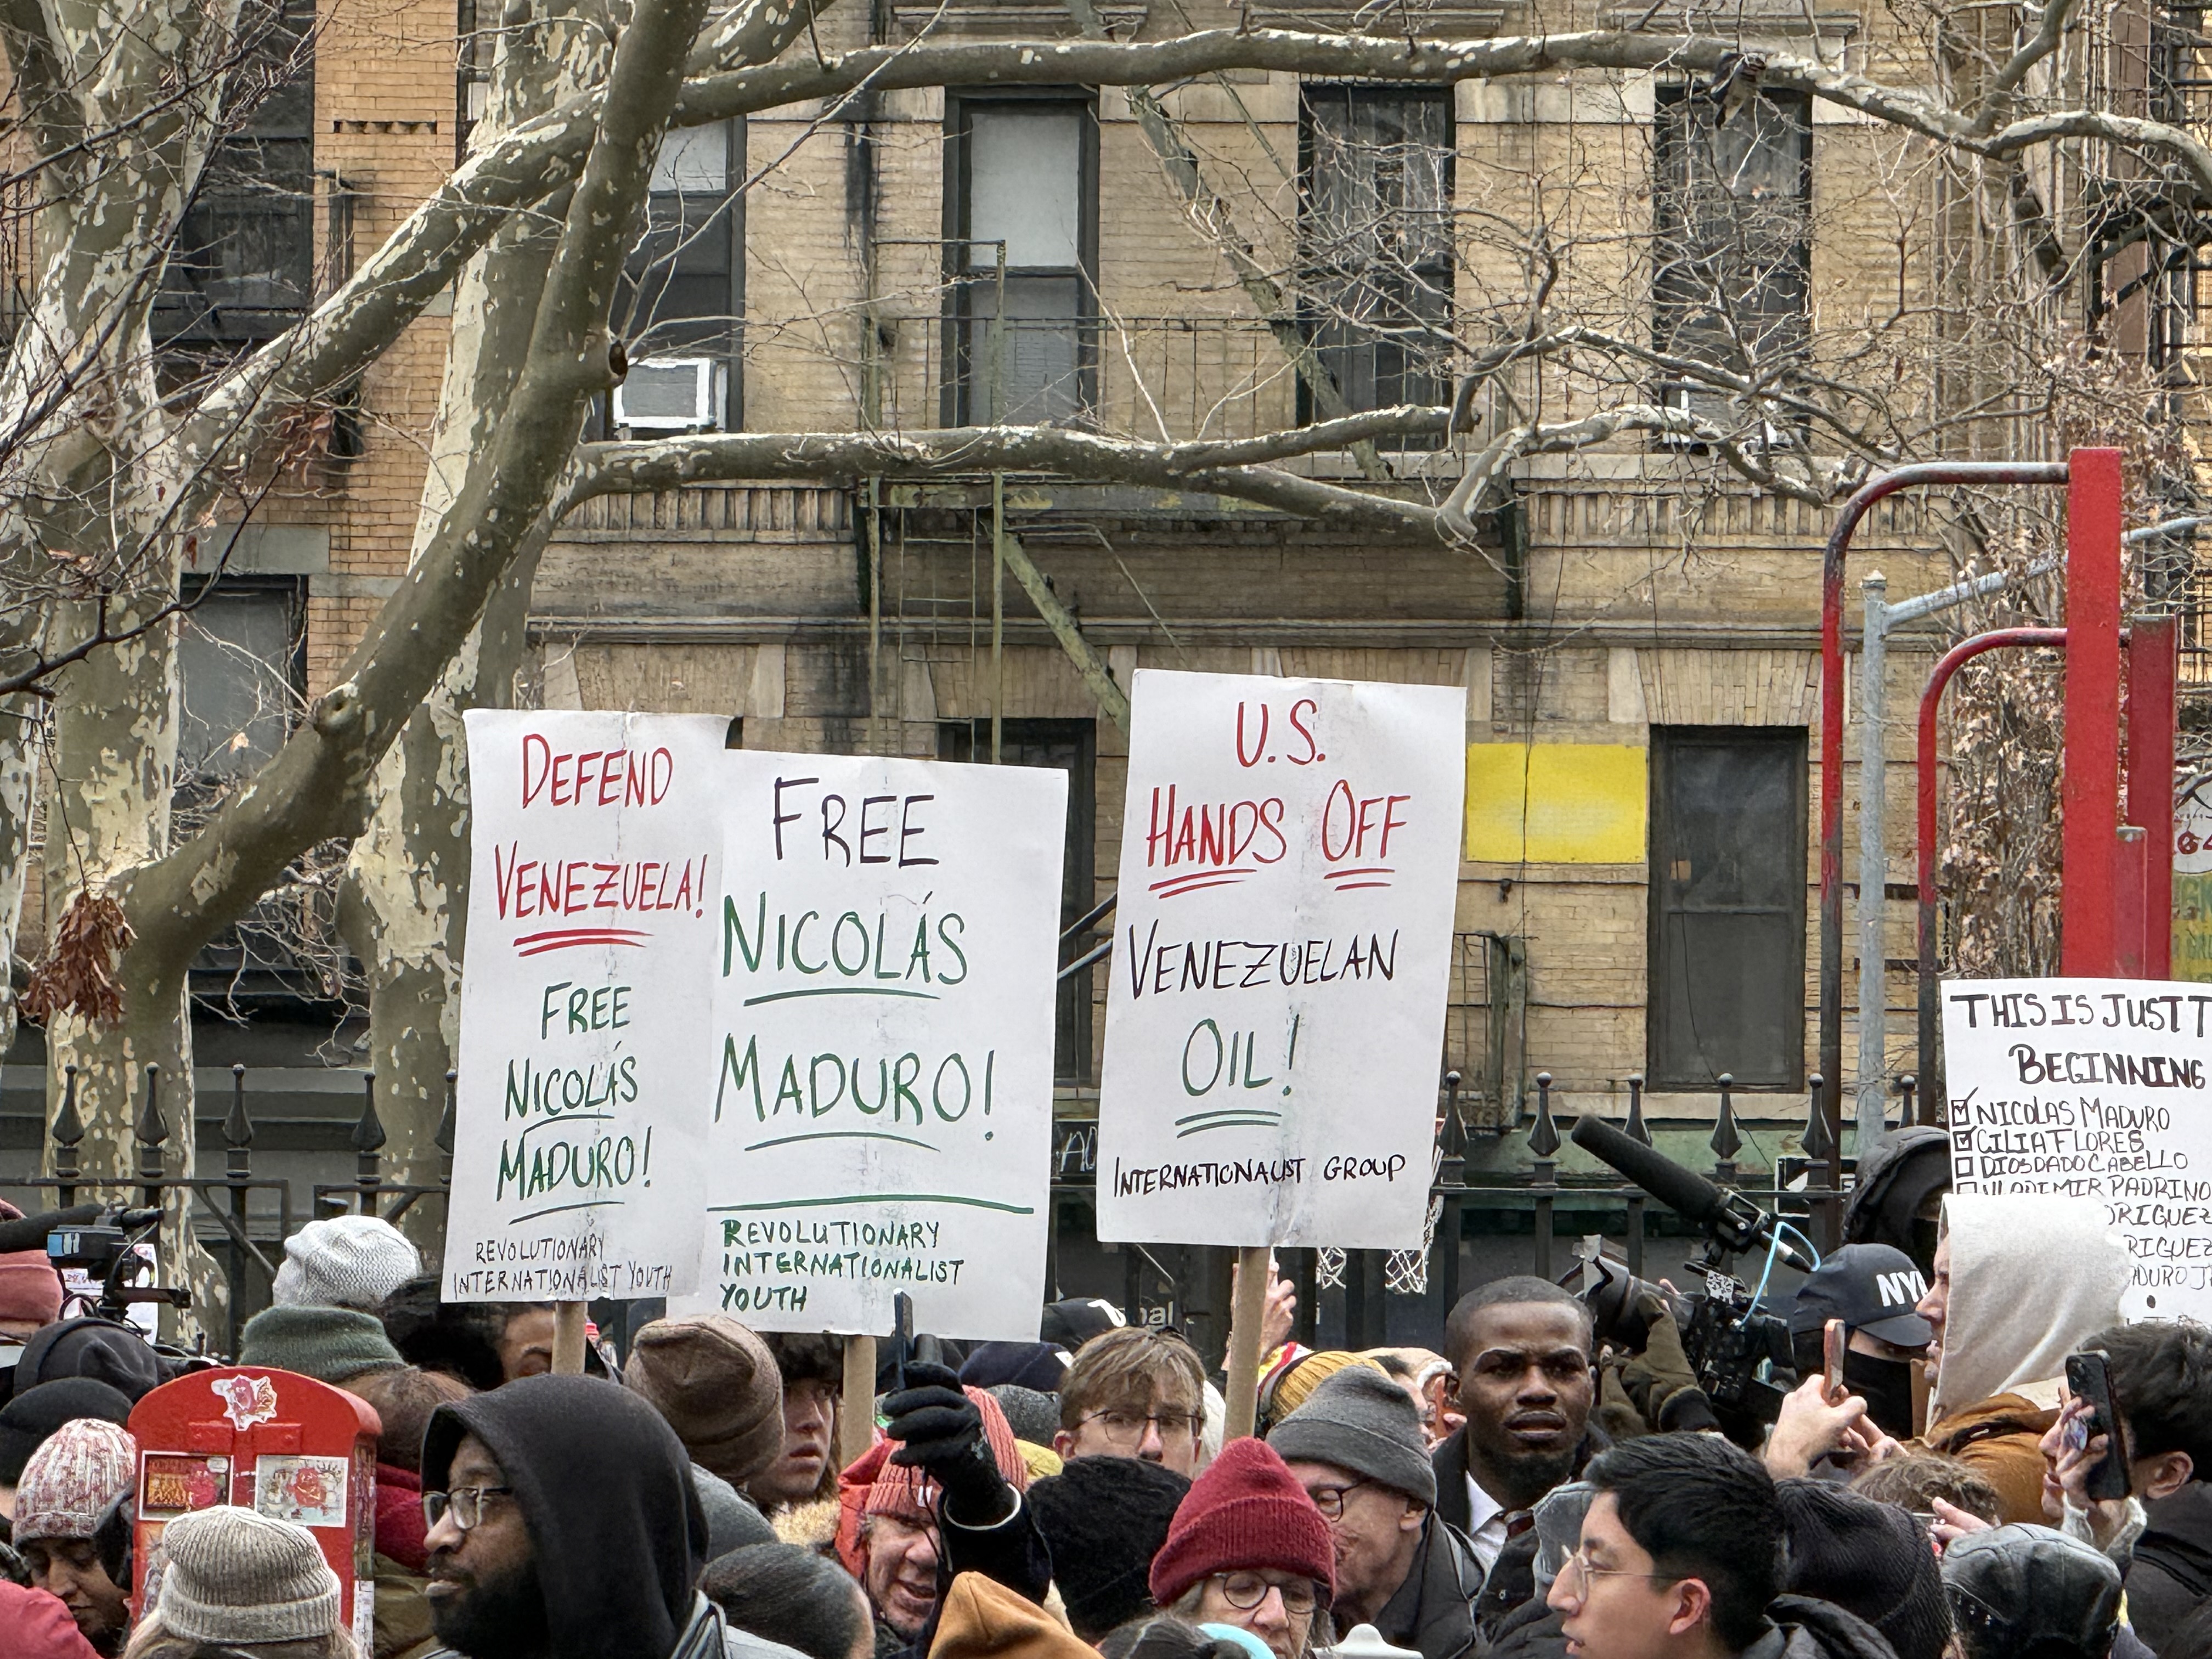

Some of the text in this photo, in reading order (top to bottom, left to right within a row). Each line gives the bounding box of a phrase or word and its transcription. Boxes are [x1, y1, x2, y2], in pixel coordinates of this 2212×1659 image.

[1236, 698, 1326, 768] U.S.
[522, 733, 673, 809] DEFEND
[773, 776, 940, 869] FREE
[1146, 779, 1411, 867] HANDS OFF
[494, 840, 708, 921] VENEZUELA!
[723, 890, 968, 985] NICOLÁS
[1128, 918, 1399, 1000] VENEZUELAN
[541, 981, 632, 1040] FREE
[1950, 994, 2047, 1028] THIS
[2051, 994, 2095, 1026] IS
[2101, 993, 2183, 1033] JUST
[1182, 1013, 1300, 1097] OIL!
[2008, 1043, 2206, 1090] BEGINNING
[505, 1040, 639, 1121] NICOLÁS
[714, 1032, 995, 1141] MADURO!
[1976, 1095, 2170, 1133] NICOLAS MADURO
[496, 1125, 652, 1202] MADURO!
[1977, 1128, 2145, 1154] CILIA FLORES
[1980, 1149, 2188, 1179] DIOSDADO CABELLO
[1114, 1154, 1406, 1198] INTERNATIONALIST GROUP
[2107, 1174, 2211, 1201] PADRINO
[476, 1232, 603, 1264] REVOLUTIONARY
[720, 1219, 940, 1249] REVOLUTIONARY
[2123, 1234, 2212, 1262] RIGUEZ
[454, 1260, 673, 1300] INTERNATIONALIST YOUTH
[723, 1251, 965, 1285] INTERNATIONALIST
[720, 1283, 808, 1312] YOUTH
